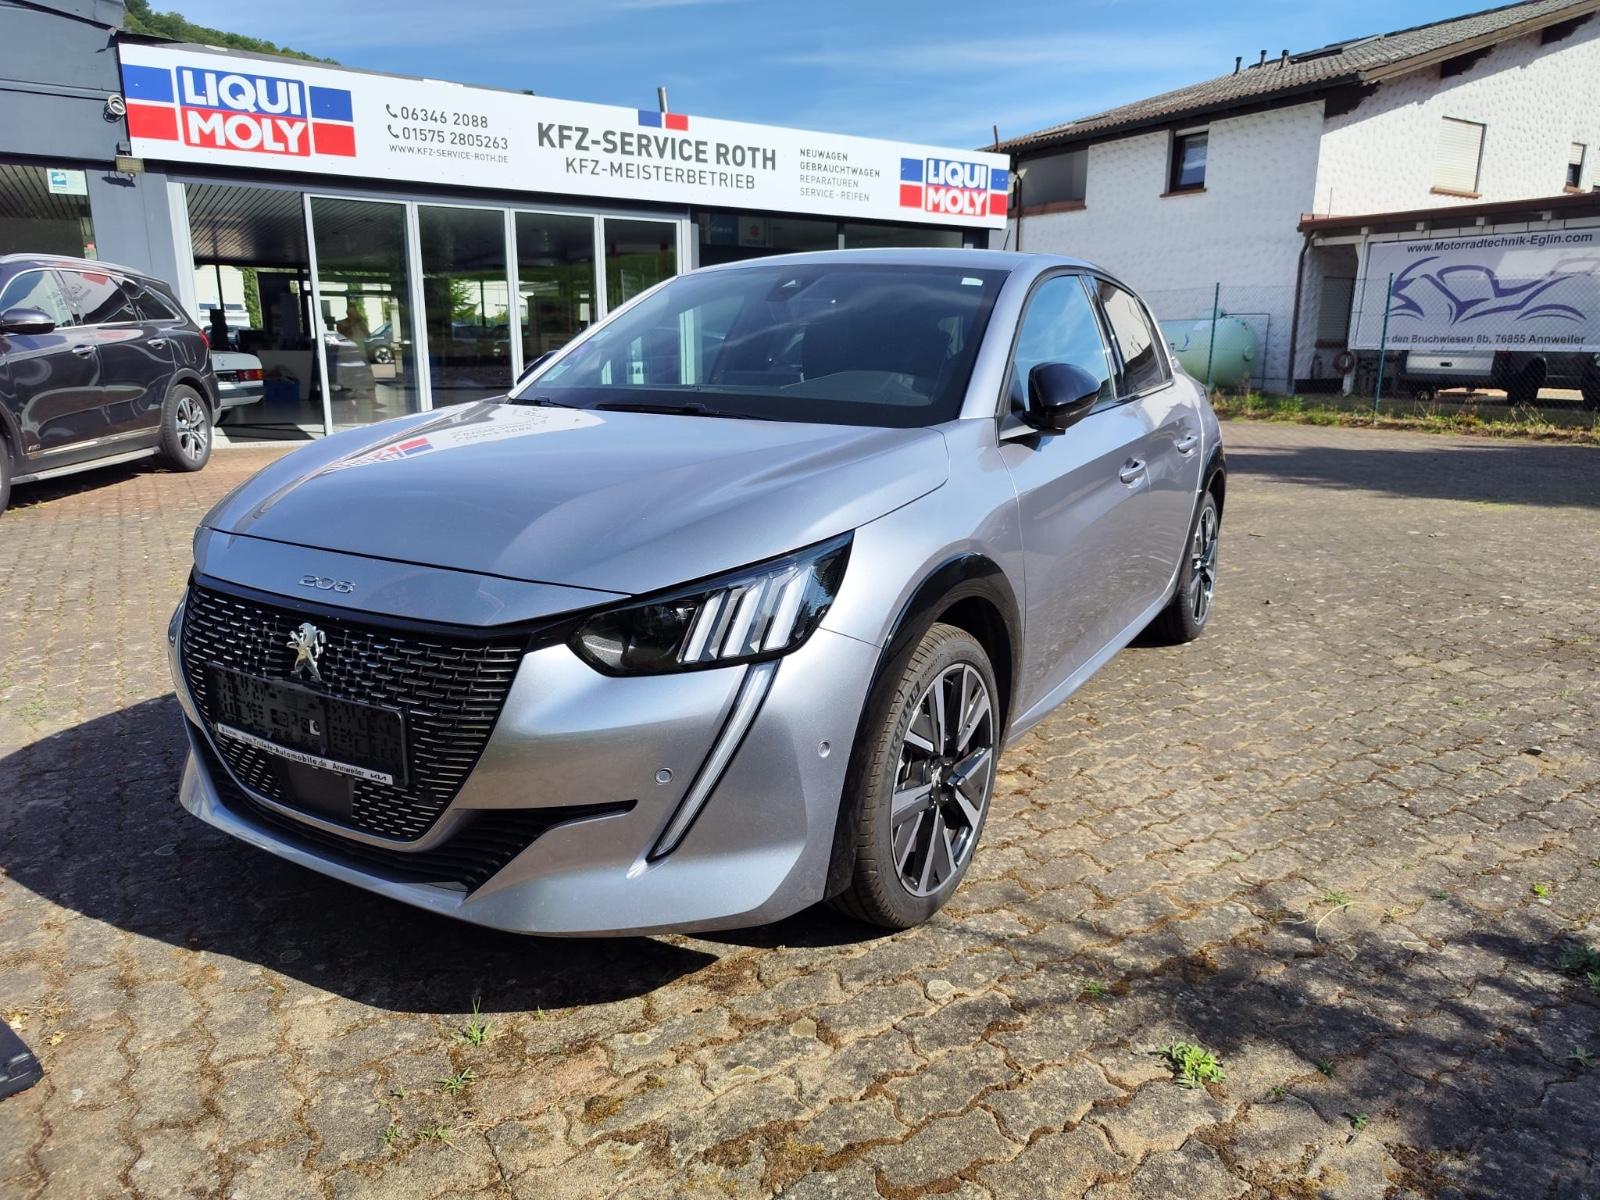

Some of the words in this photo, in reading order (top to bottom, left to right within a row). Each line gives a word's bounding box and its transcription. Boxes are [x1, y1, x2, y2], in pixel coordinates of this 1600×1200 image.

[182, 70, 302, 115] LIQUI
[400, 106, 448, 124] 06346
[452, 112, 489, 129] 2088
[187, 110, 307, 153] MOLY
[402, 126, 445, 143] 01575
[449, 131, 508, 150] 2805263
[389, 144, 509, 164] WWW.KFZ-SERVICE-ROTH.DE
[537, 122, 708, 164] KFZ-SERVICE
[715, 142, 777, 171] ROTH
[800, 148, 848, 161] NEUWAGEN
[565, 157, 755, 190] KFZ-MEISTERBETRIEB
[800, 161, 880, 178] GEBRAUCHTWAGEN
[927, 159, 987, 189] LIQUI
[800, 174, 859, 188] REPARATUREN
[927, 187, 987, 215] MOLY
[1407, 232, 1593, 252] www.Motorradtechnik-Eglin.com
[1391, 335, 1409, 343] den
[1411, 334, 1474, 344] Bruchwiesen
[1476, 334, 1492, 345] 8b,
[1494, 334, 1526, 344] 76855
[1528, 334, 1585, 345] Annweiler
[298, 575, 356, 593] 208
[332, 762, 366, 777] Annweiler
